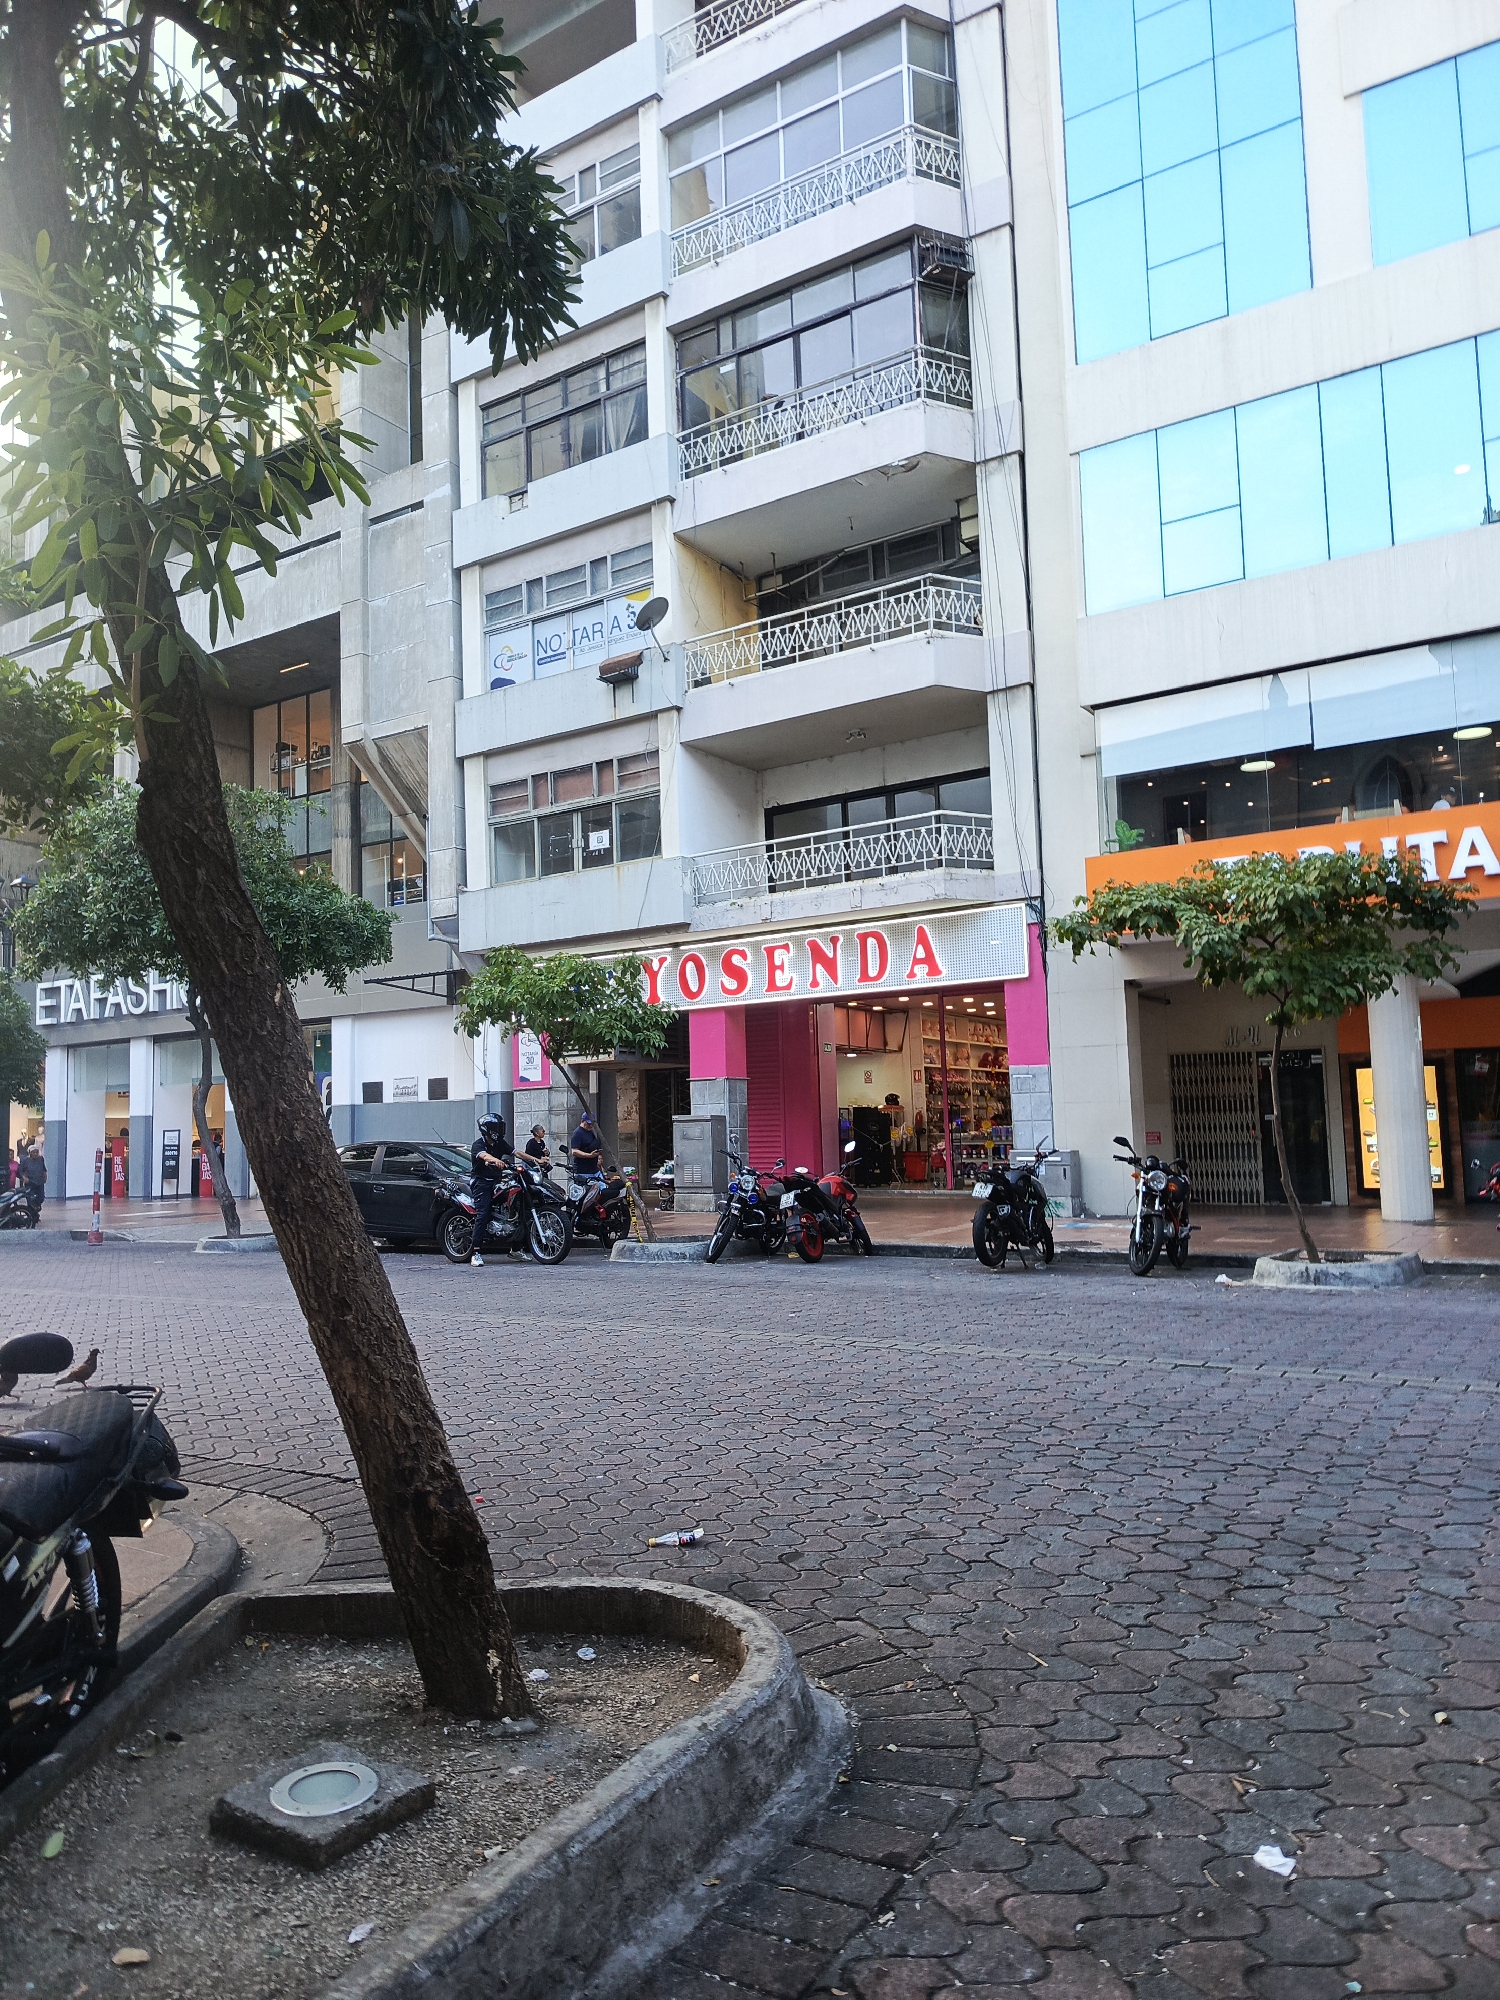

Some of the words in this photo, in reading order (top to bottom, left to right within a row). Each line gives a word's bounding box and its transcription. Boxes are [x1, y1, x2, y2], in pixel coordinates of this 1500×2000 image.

[536, 615, 622, 657] NOTARA
[640, 923, 944, 1006] YOSENDA
[525, 1056, 535, 1065] 30
